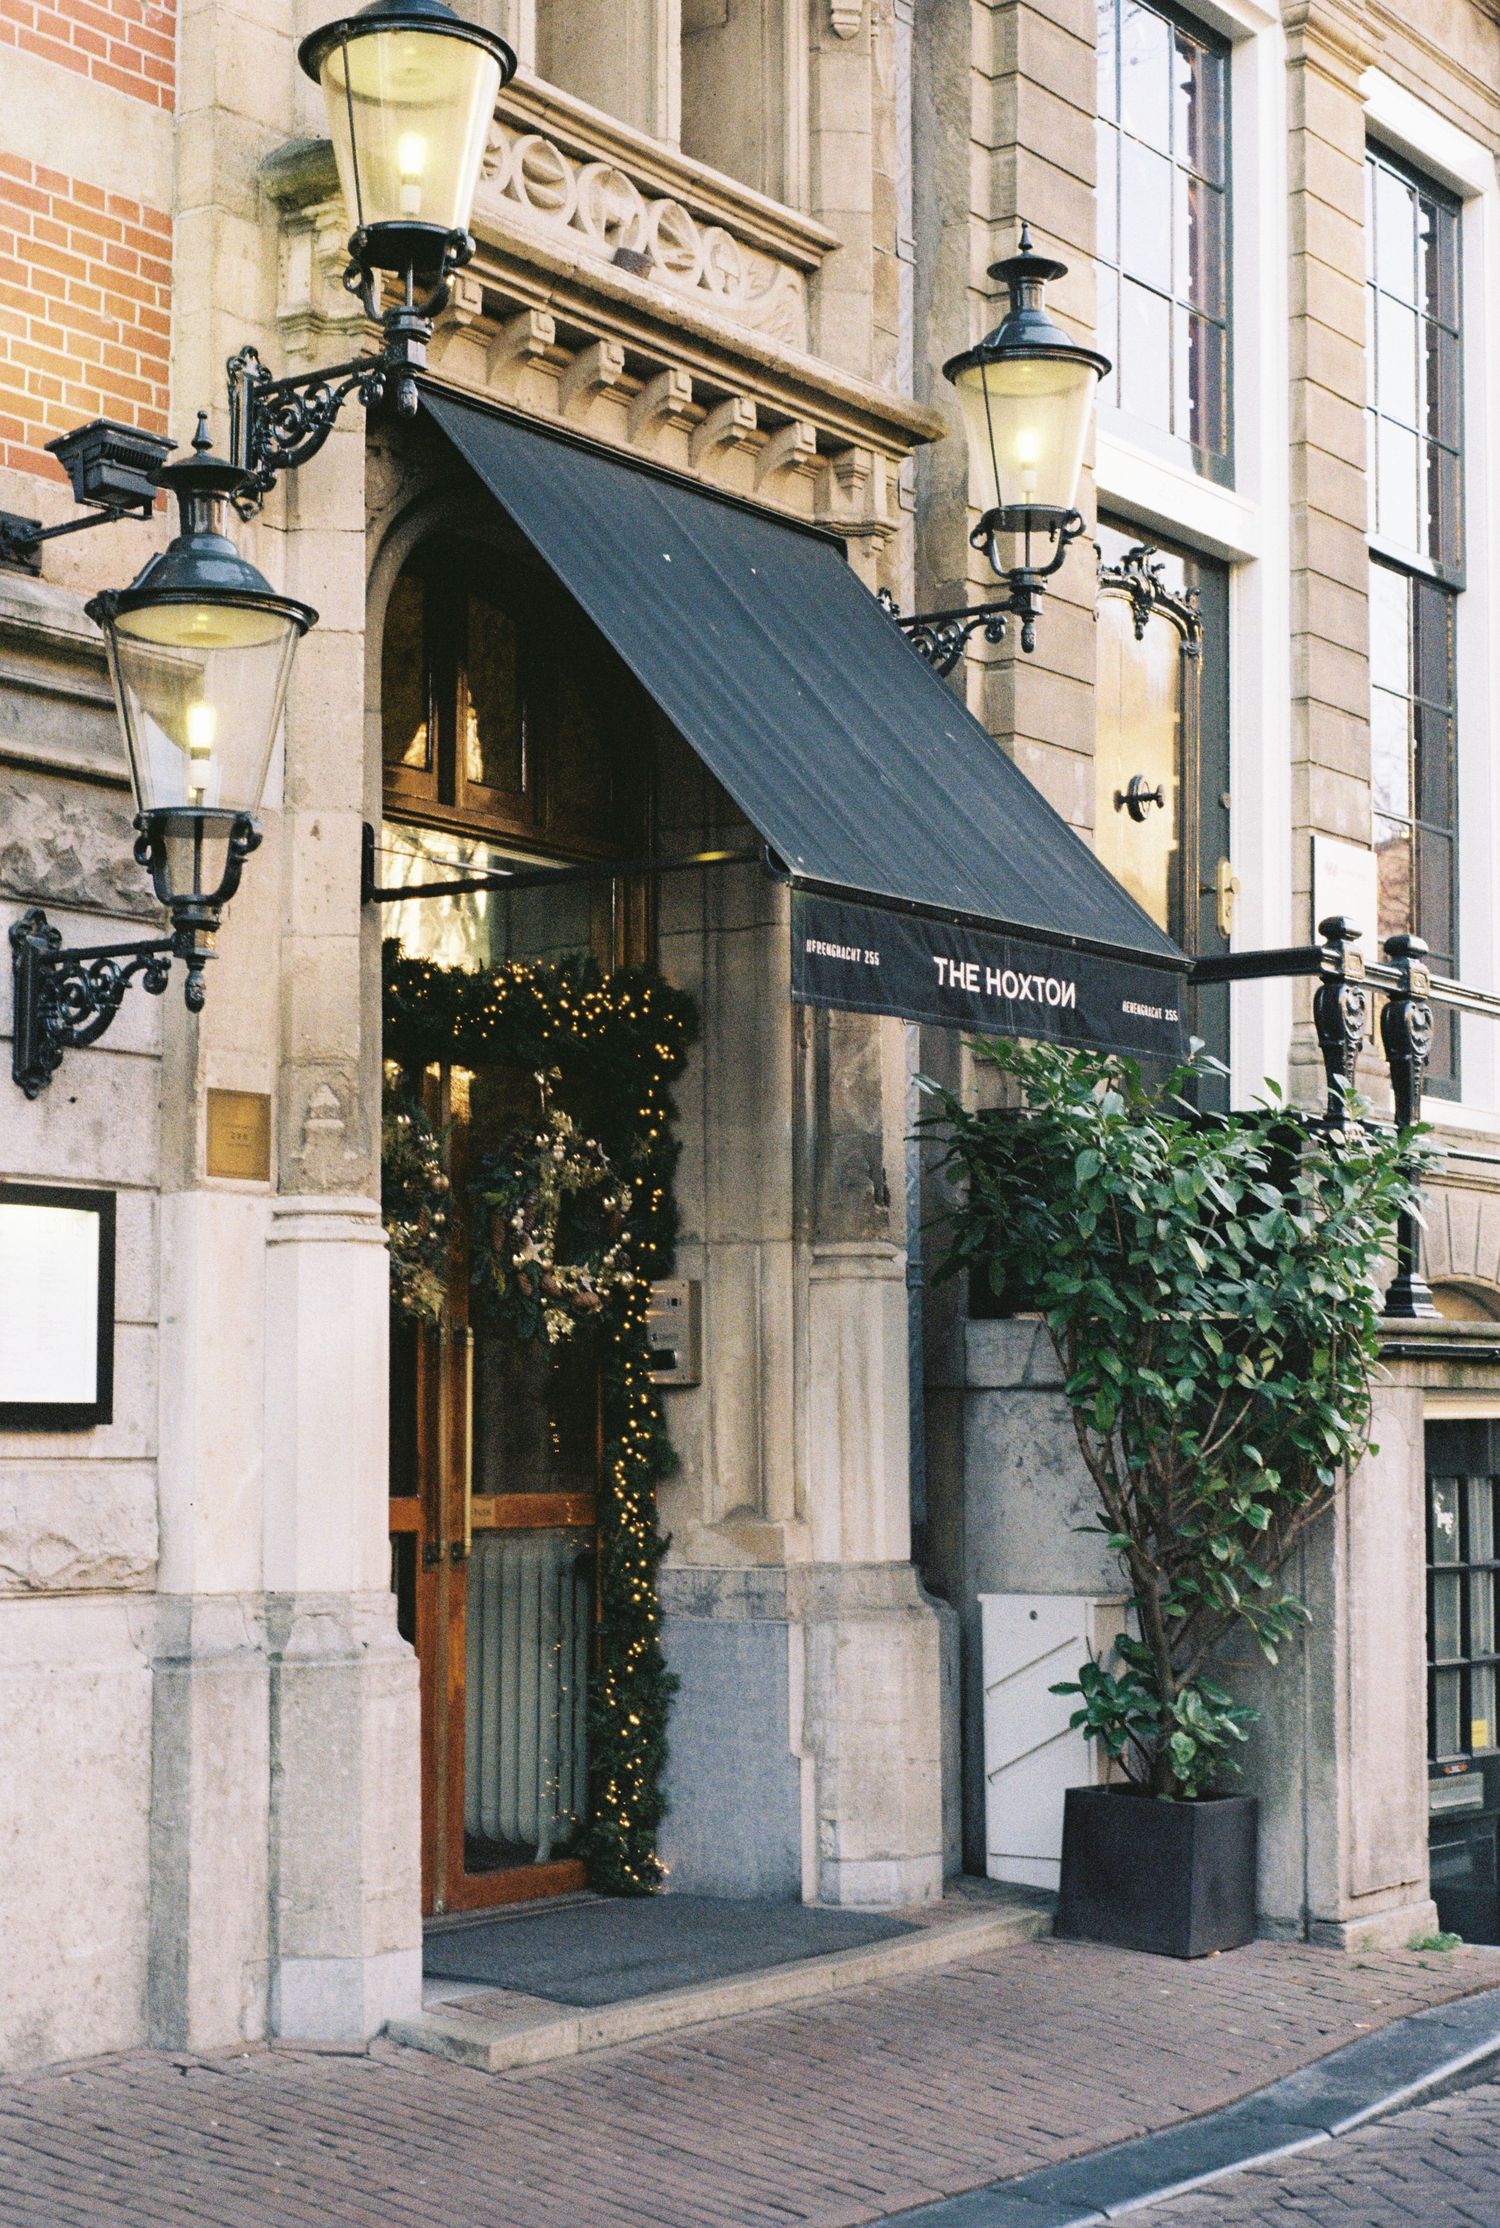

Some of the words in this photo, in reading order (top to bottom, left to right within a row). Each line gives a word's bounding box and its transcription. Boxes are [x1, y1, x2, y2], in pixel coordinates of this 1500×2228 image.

[864, 949, 880, 966] 255
[933, 956, 981, 993] THE
[1164, 1008, 1179, 1022] 255
